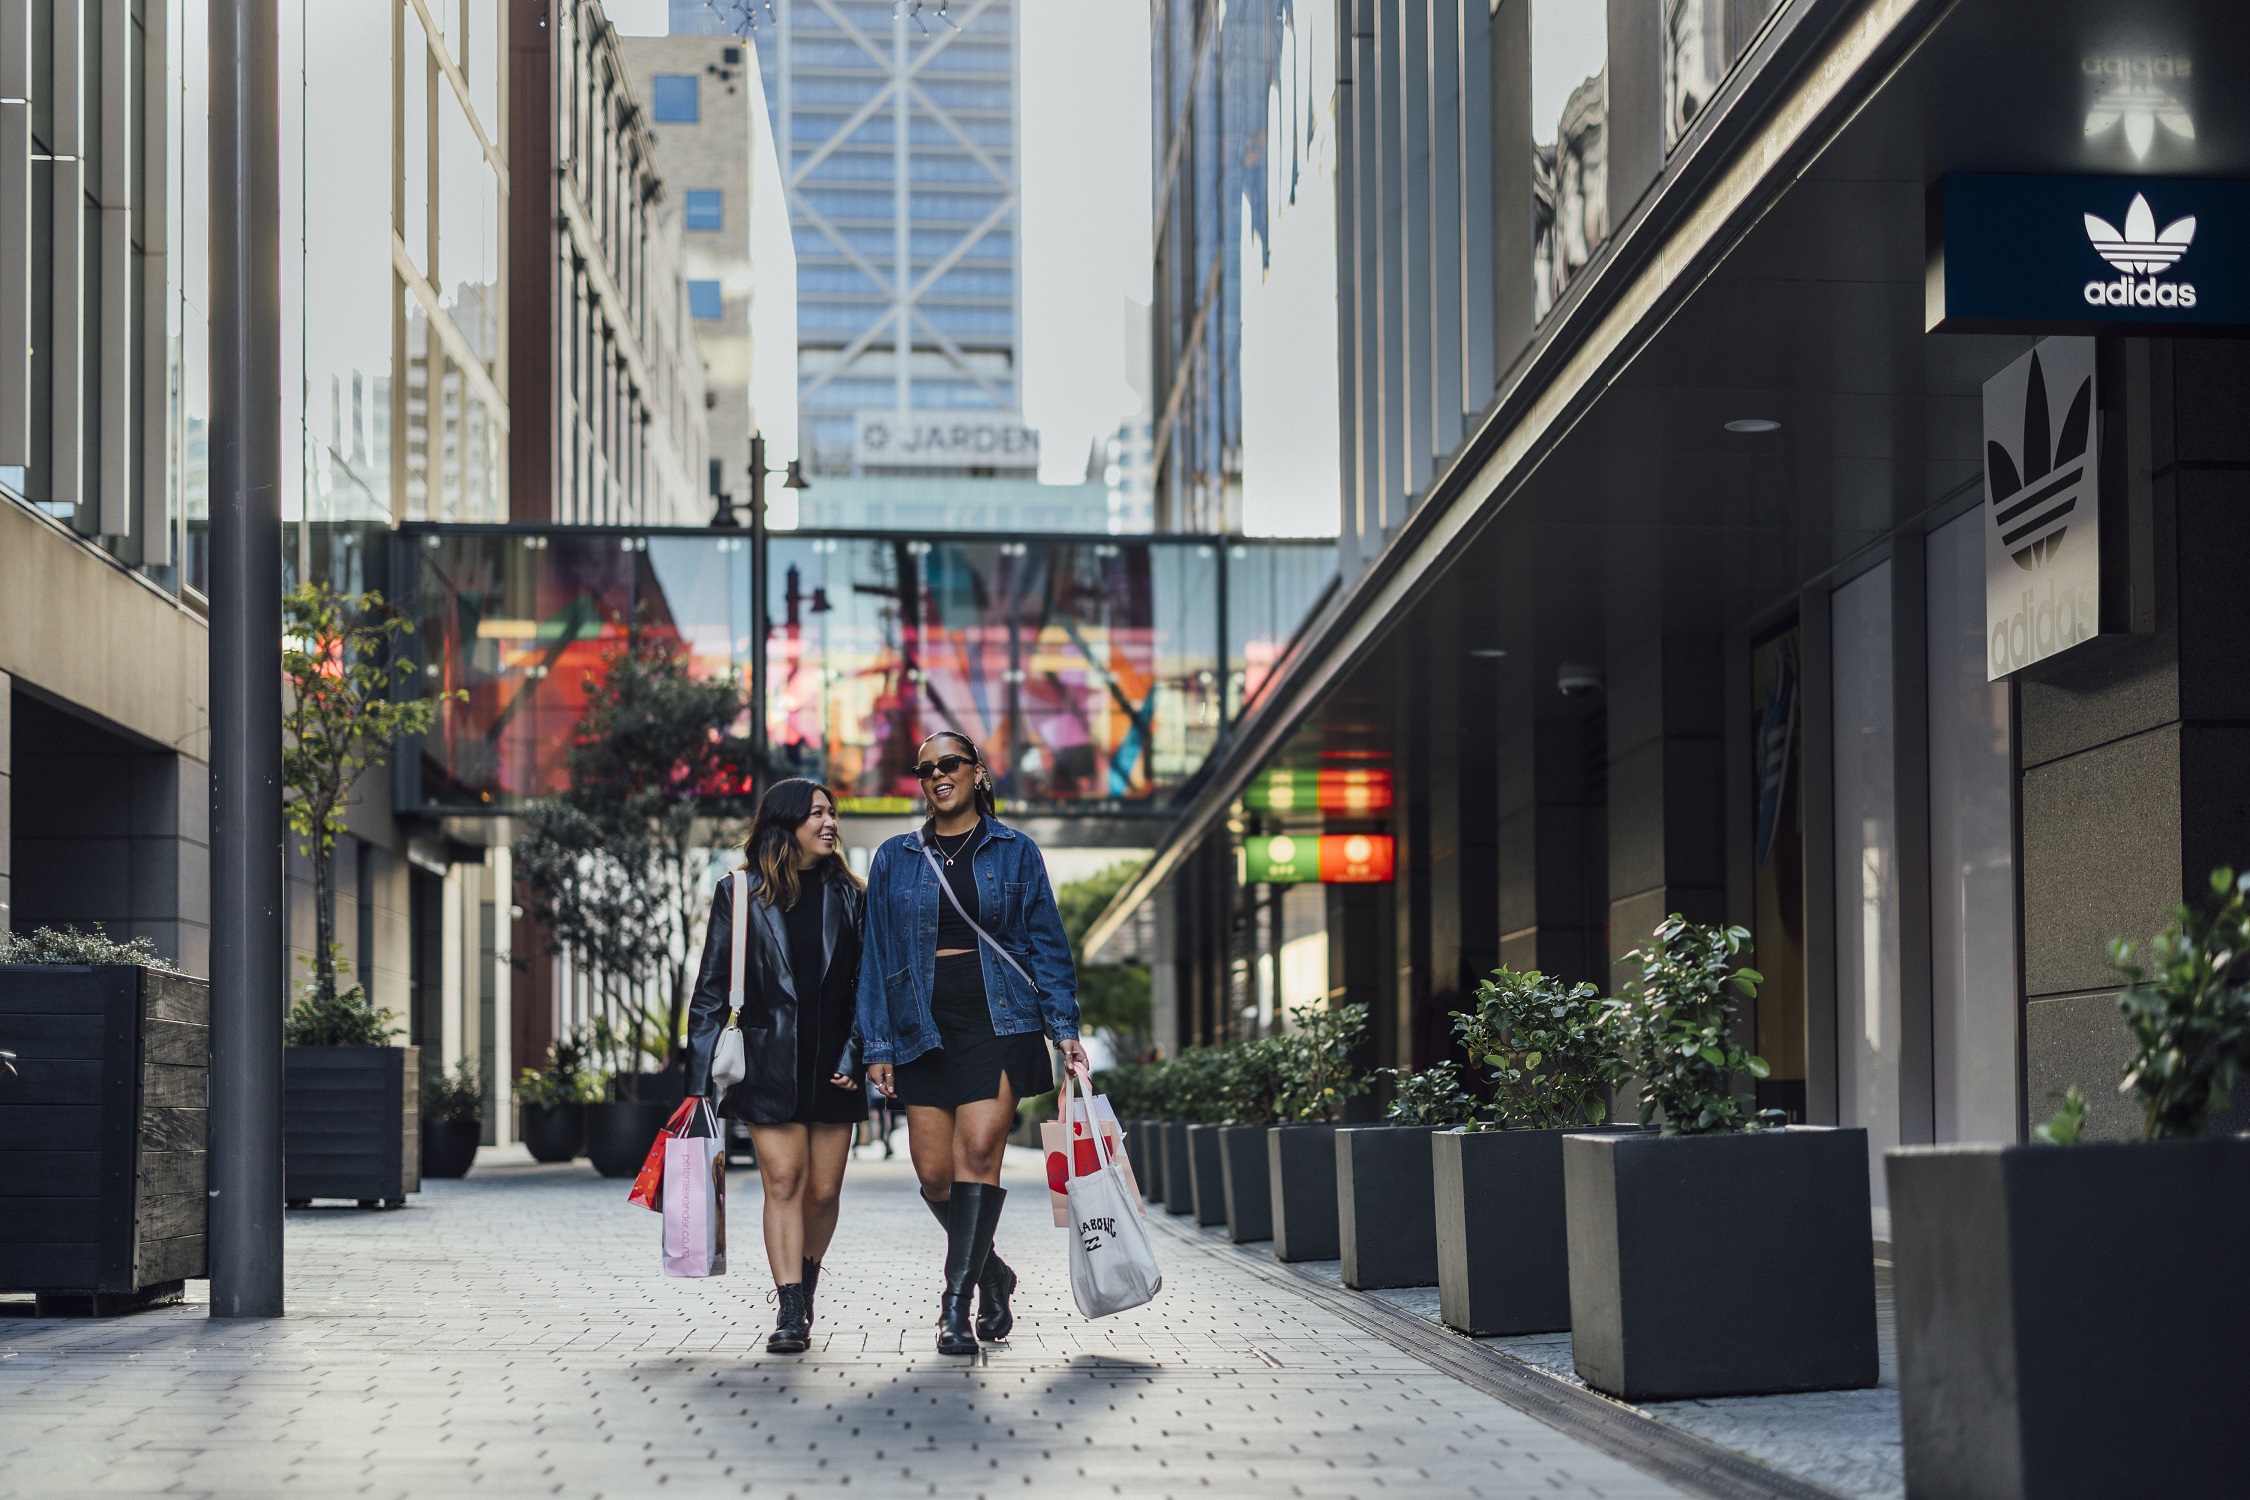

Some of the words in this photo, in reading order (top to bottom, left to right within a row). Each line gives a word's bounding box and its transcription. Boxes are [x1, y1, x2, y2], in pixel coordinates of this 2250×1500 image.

[2084, 275, 2197, 307] adidas
[1991, 578, 2097, 676] adidas
[681, 1154, 692, 1258] peteralexander.co.nz
